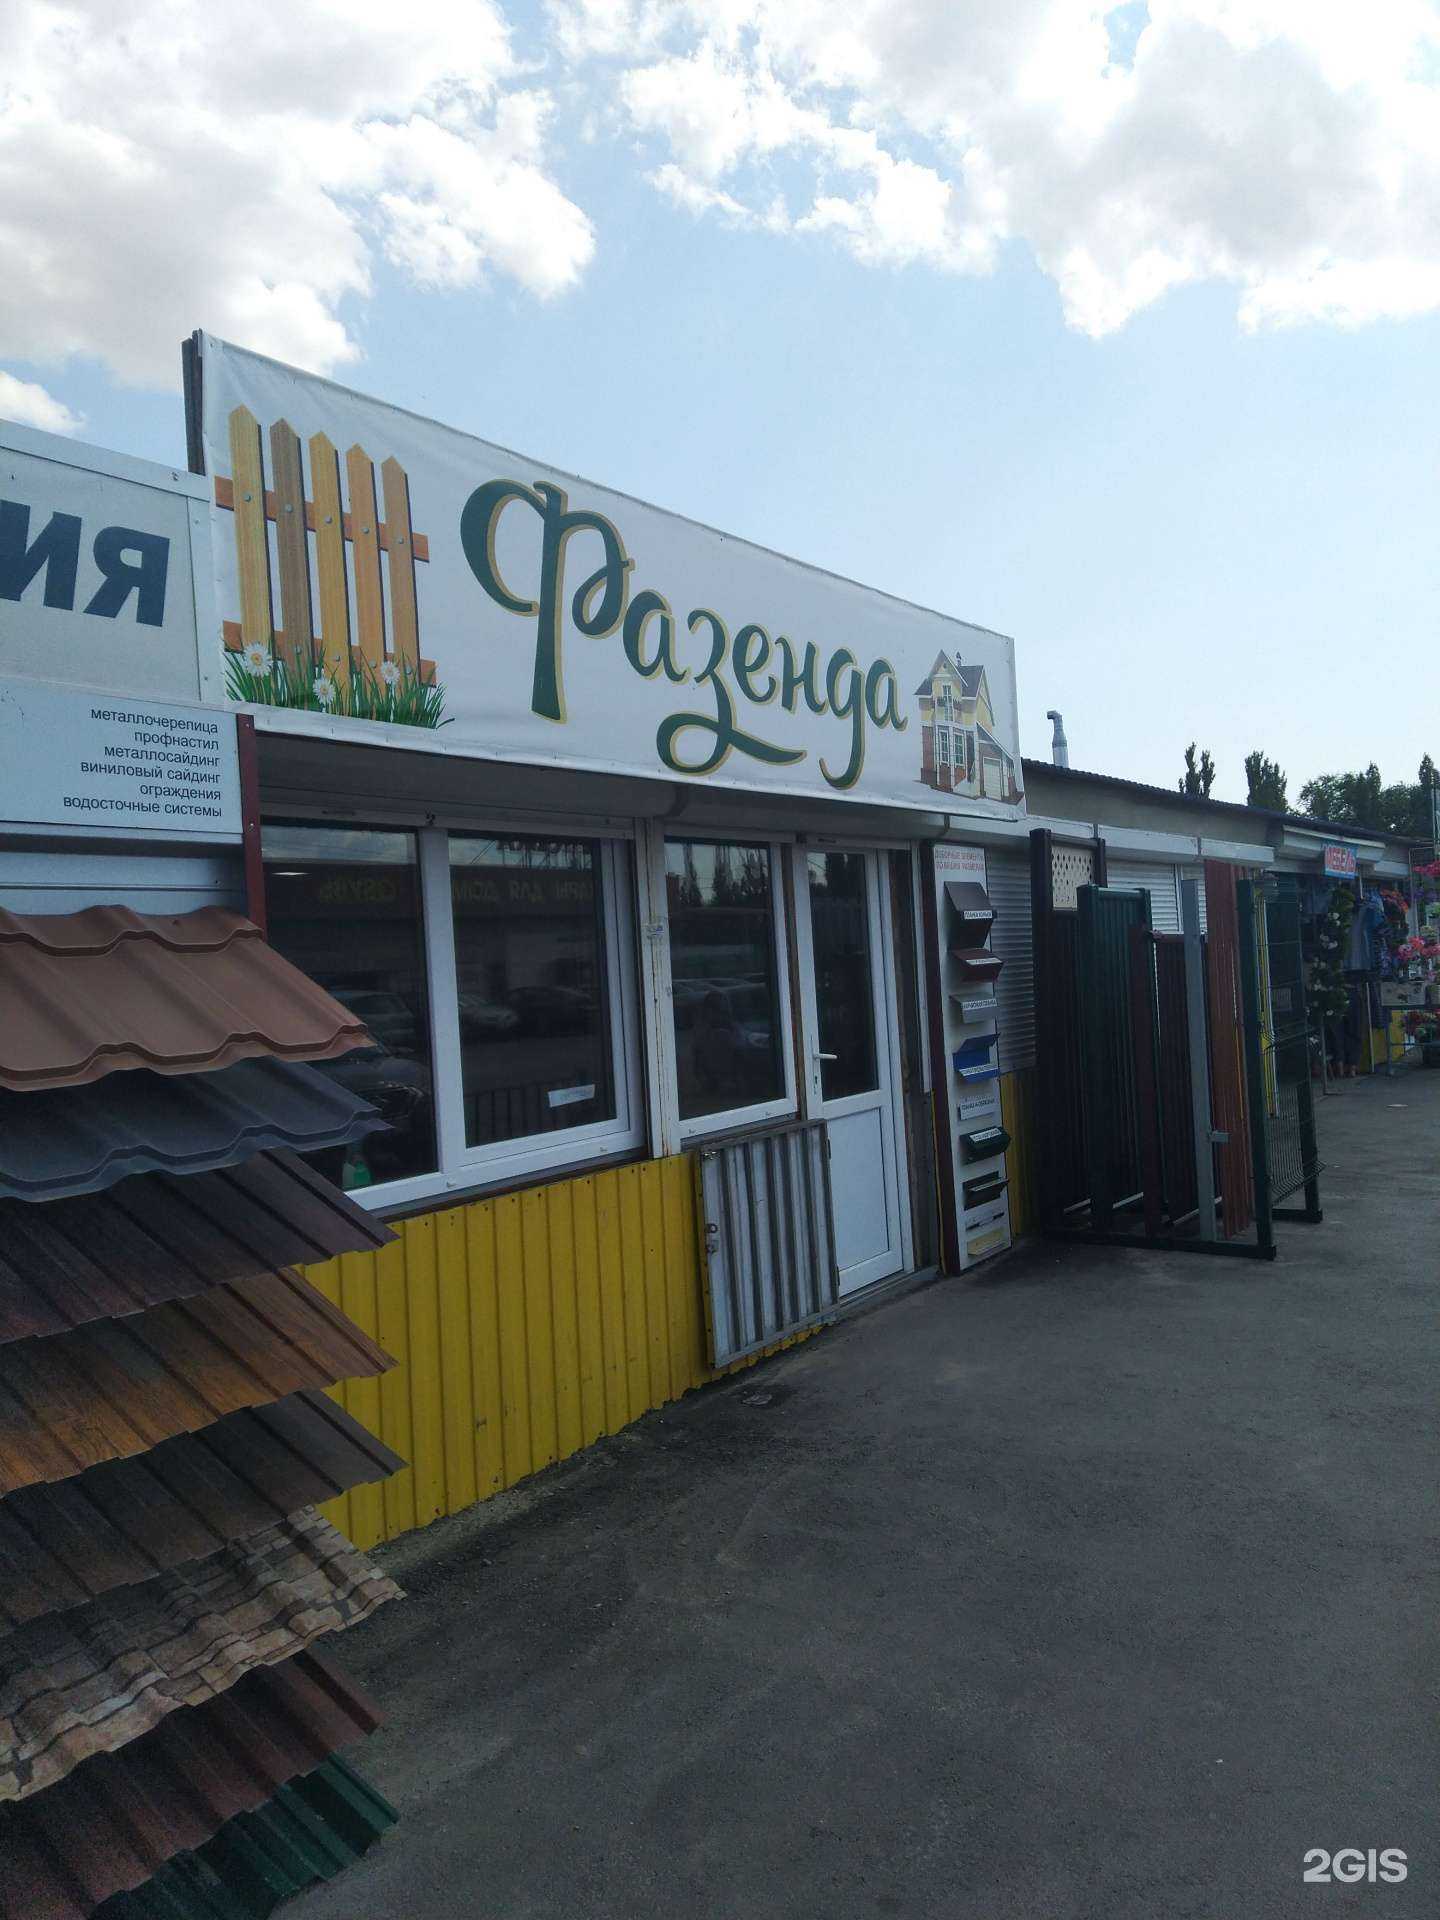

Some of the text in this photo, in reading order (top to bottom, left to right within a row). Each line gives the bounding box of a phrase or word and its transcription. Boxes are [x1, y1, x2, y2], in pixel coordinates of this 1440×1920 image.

[460, 478, 908, 790] Фазенда
[91, 708, 219, 734] металлочерепица
[134, 731, 219, 751] профнастил
[104, 745, 222, 767] металлосайдинг
[80, 761, 221, 784] виниловый сайдинг
[140, 784, 222, 801] ограждения
[63, 796, 223, 817] водосточные системы
